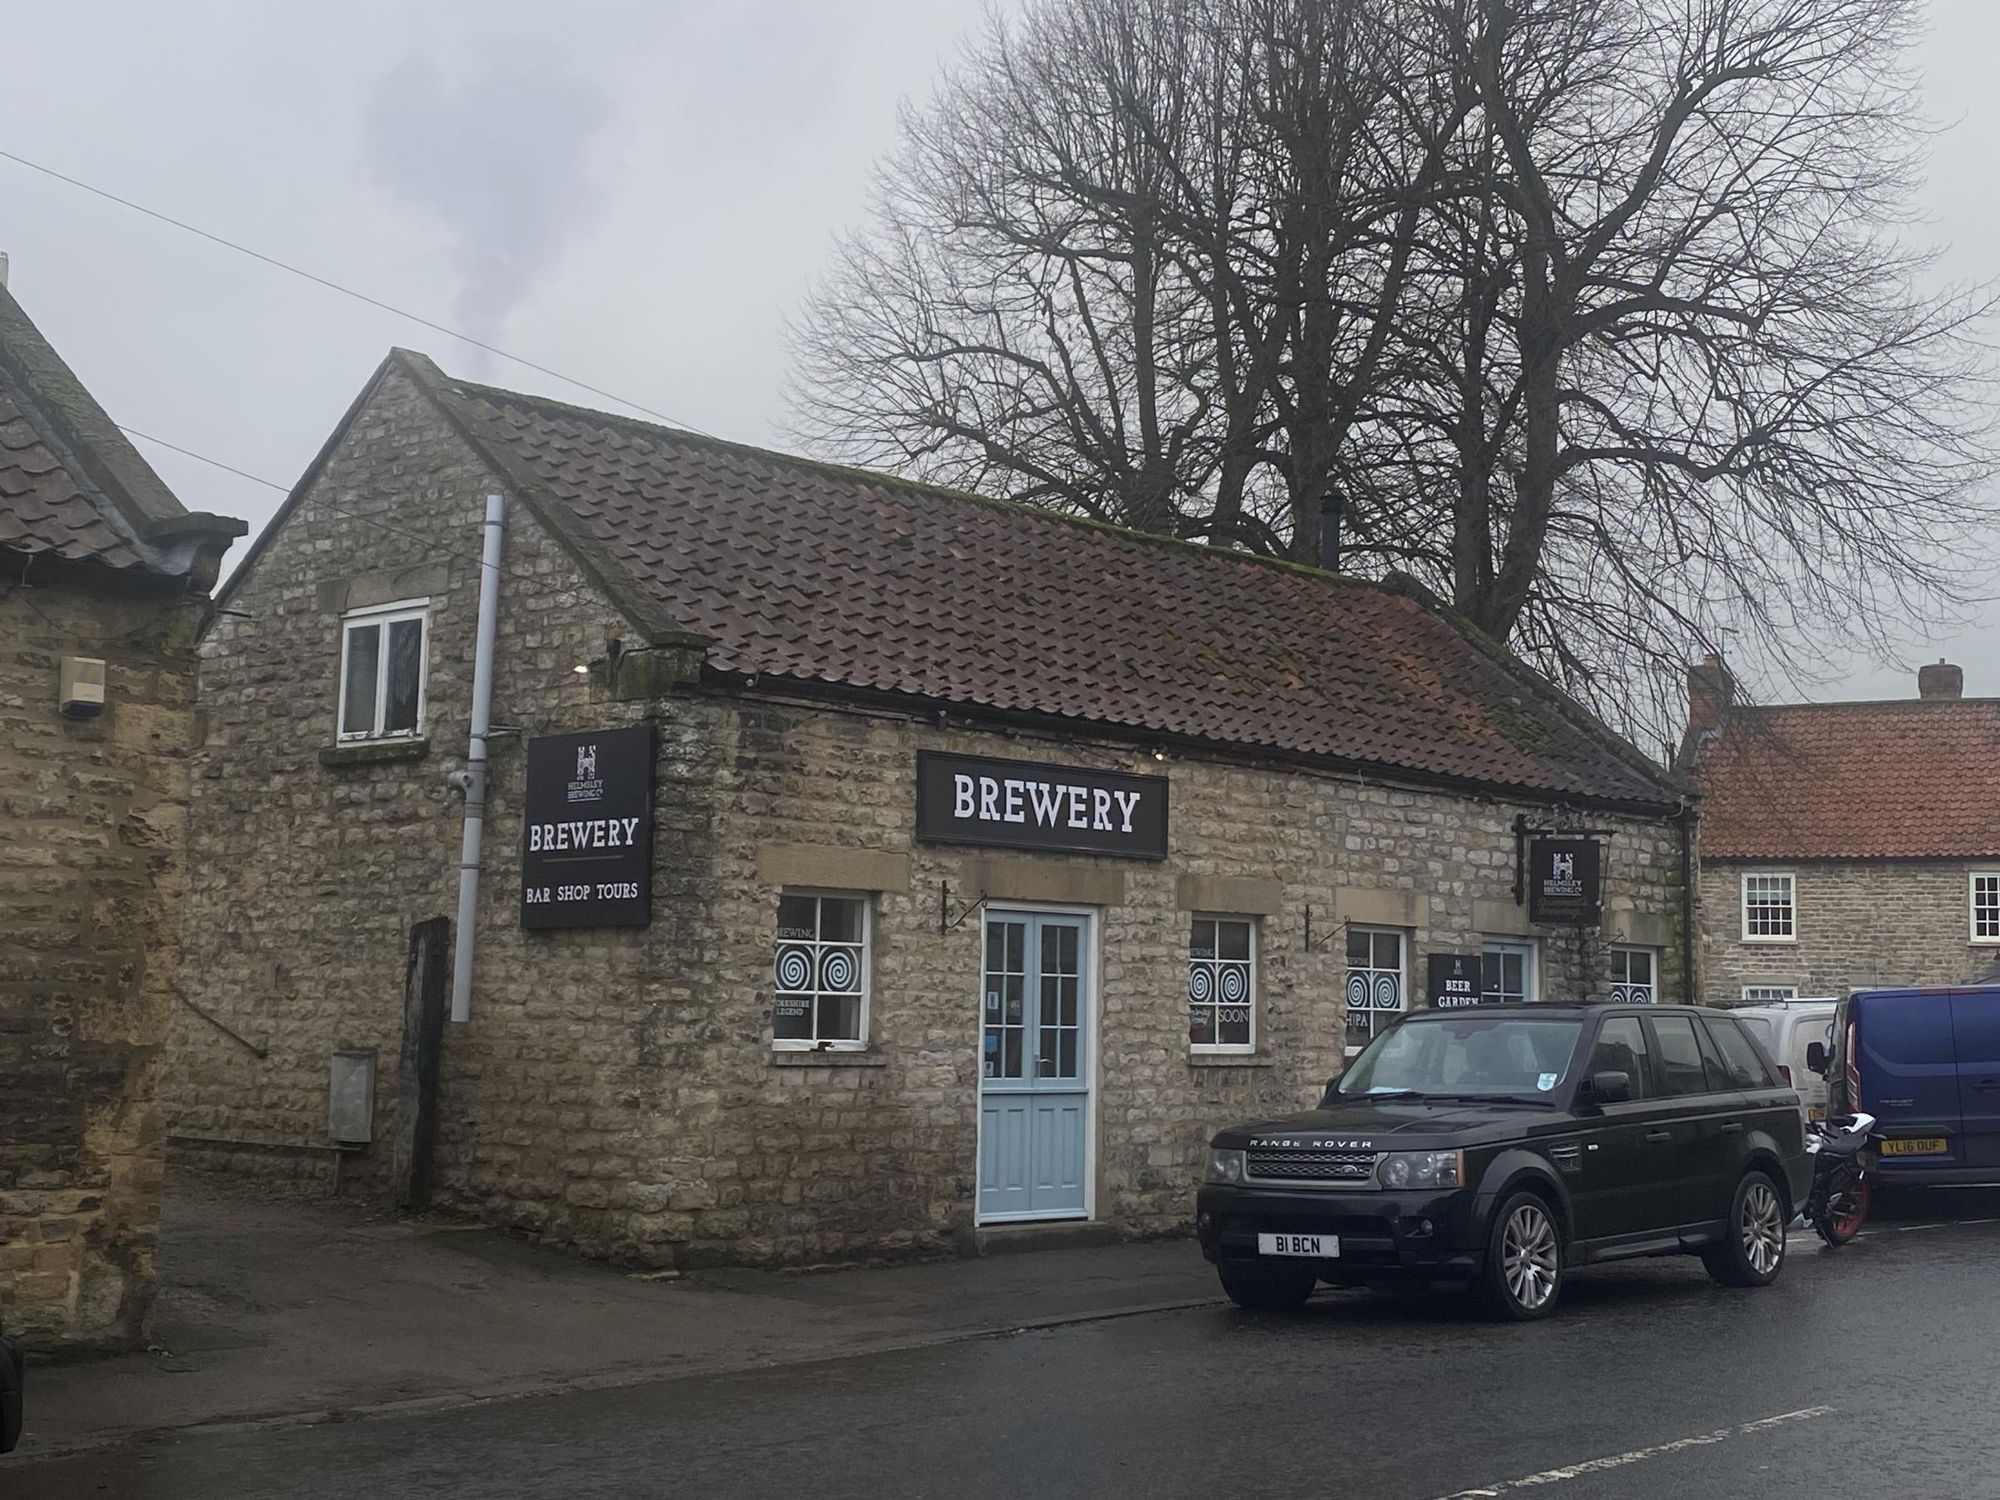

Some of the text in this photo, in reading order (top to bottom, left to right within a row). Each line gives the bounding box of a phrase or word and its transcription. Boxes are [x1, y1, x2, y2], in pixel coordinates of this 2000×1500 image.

[954, 774, 1141, 833] BREWERY
[529, 818, 639, 852] BREWERY
[526, 883, 639, 903] BAR SHOP TOURS
[777, 927, 815, 939] REWING
[1445, 979, 1471, 992] BEER
[1437, 996, 1479, 1008] GARDEN
[1218, 1008, 1249, 1023] SOON
[1249, 1139, 1372, 1149] RANGE ROVER
[1292, 1236, 1320, 1253] BCN
